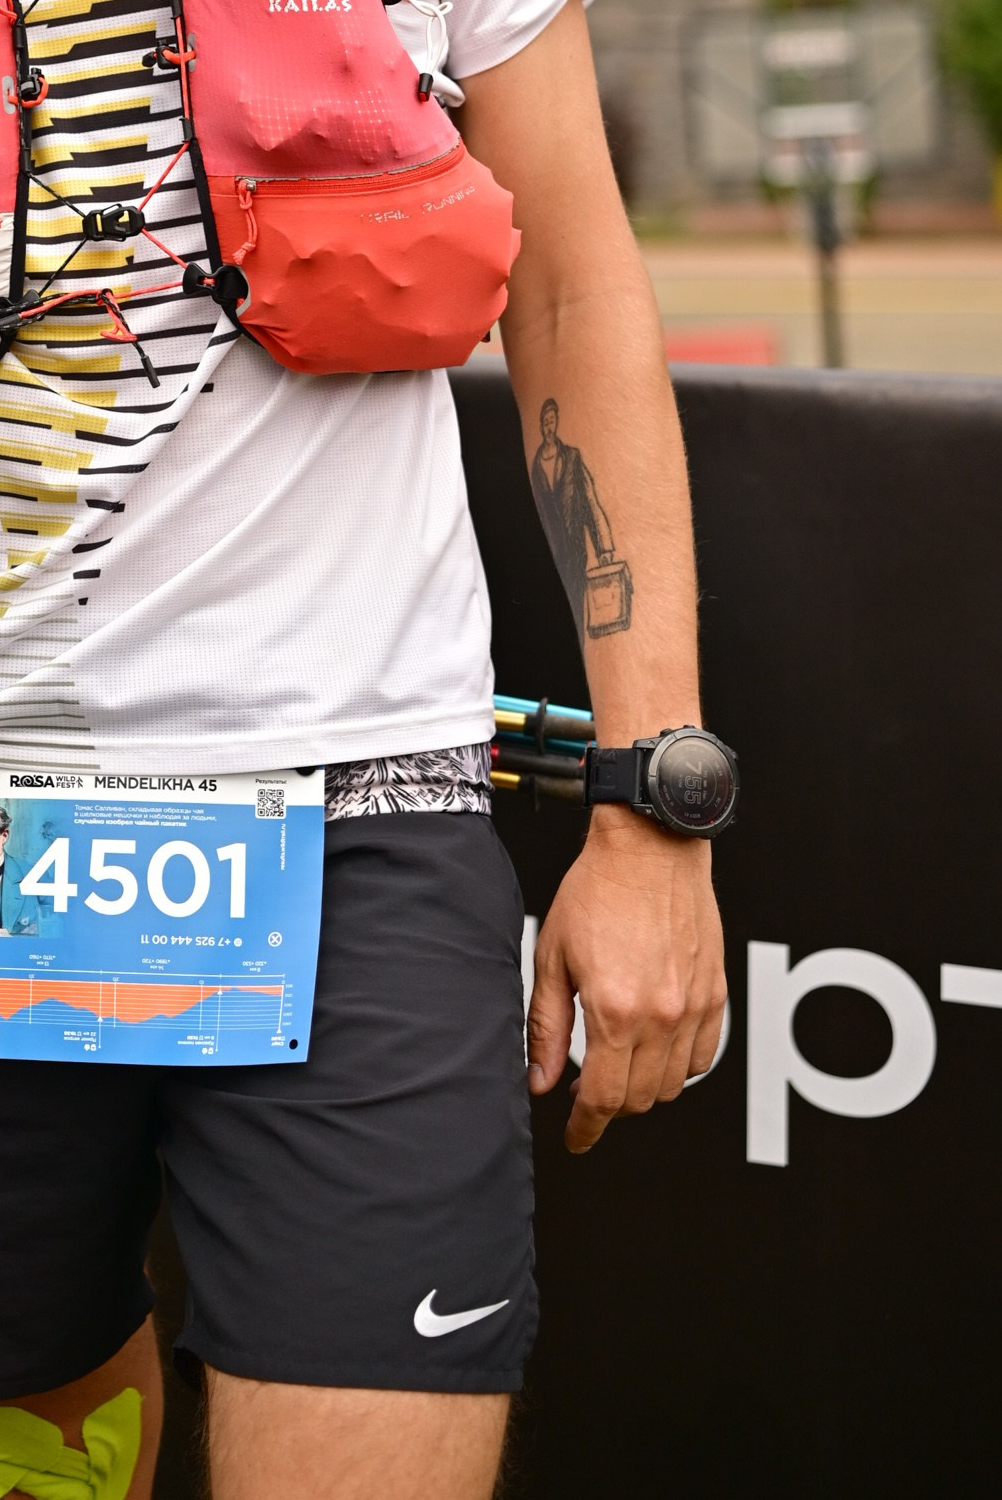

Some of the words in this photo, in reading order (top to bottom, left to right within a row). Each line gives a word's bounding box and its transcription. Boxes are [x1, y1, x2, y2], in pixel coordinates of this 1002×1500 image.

[94, 776, 194, 791] MENDELIKHA
[198, 780, 217, 792] 45
[19, 837, 246, 918] 4501
[141, 934, 149, 944] 11
[152, 935, 167, 945] 00
[171, 935, 192, 945] 444
[195, 936, 214, 946] 925
[218, 937, 231, 946] +7
